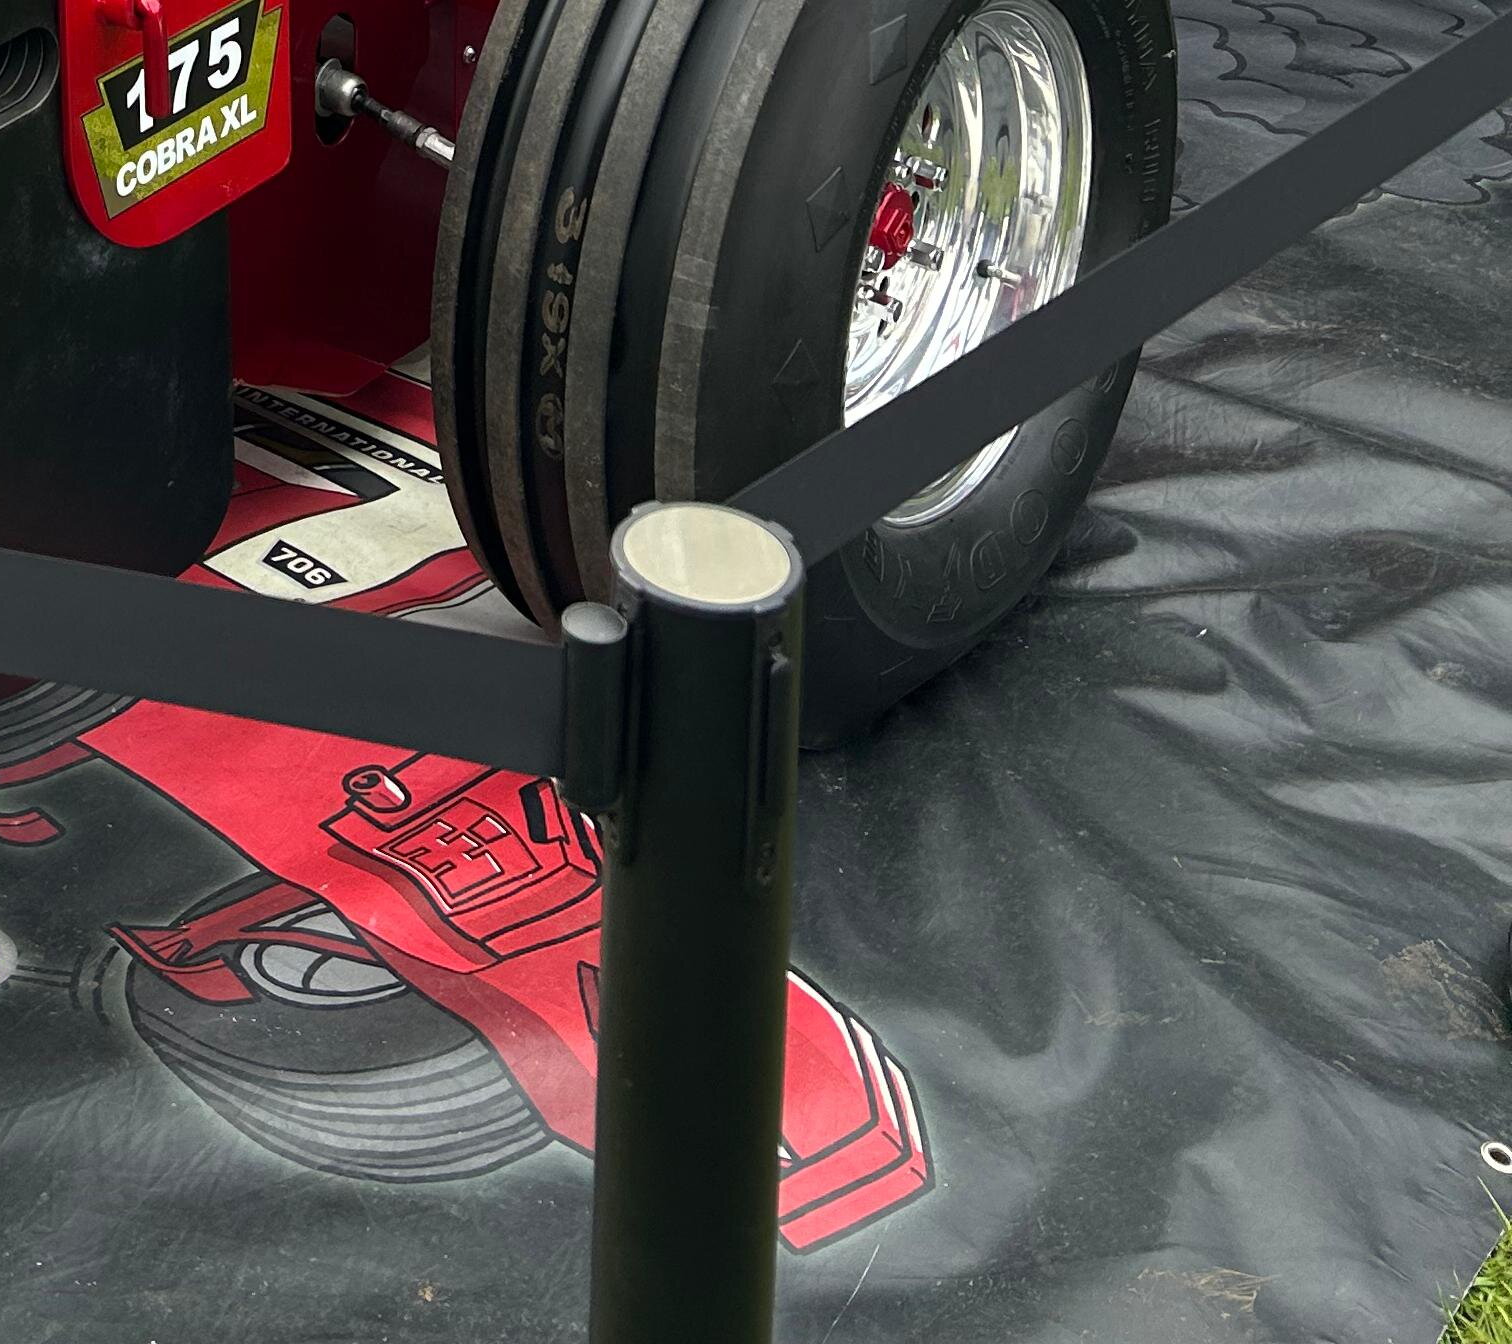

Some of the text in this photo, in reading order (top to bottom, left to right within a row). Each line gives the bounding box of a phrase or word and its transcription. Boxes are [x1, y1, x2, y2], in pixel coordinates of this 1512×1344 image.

[125, 16, 243, 134] 175
[116, 93, 258, 198] COBRA XL
[270, 546, 332, 587] 706
